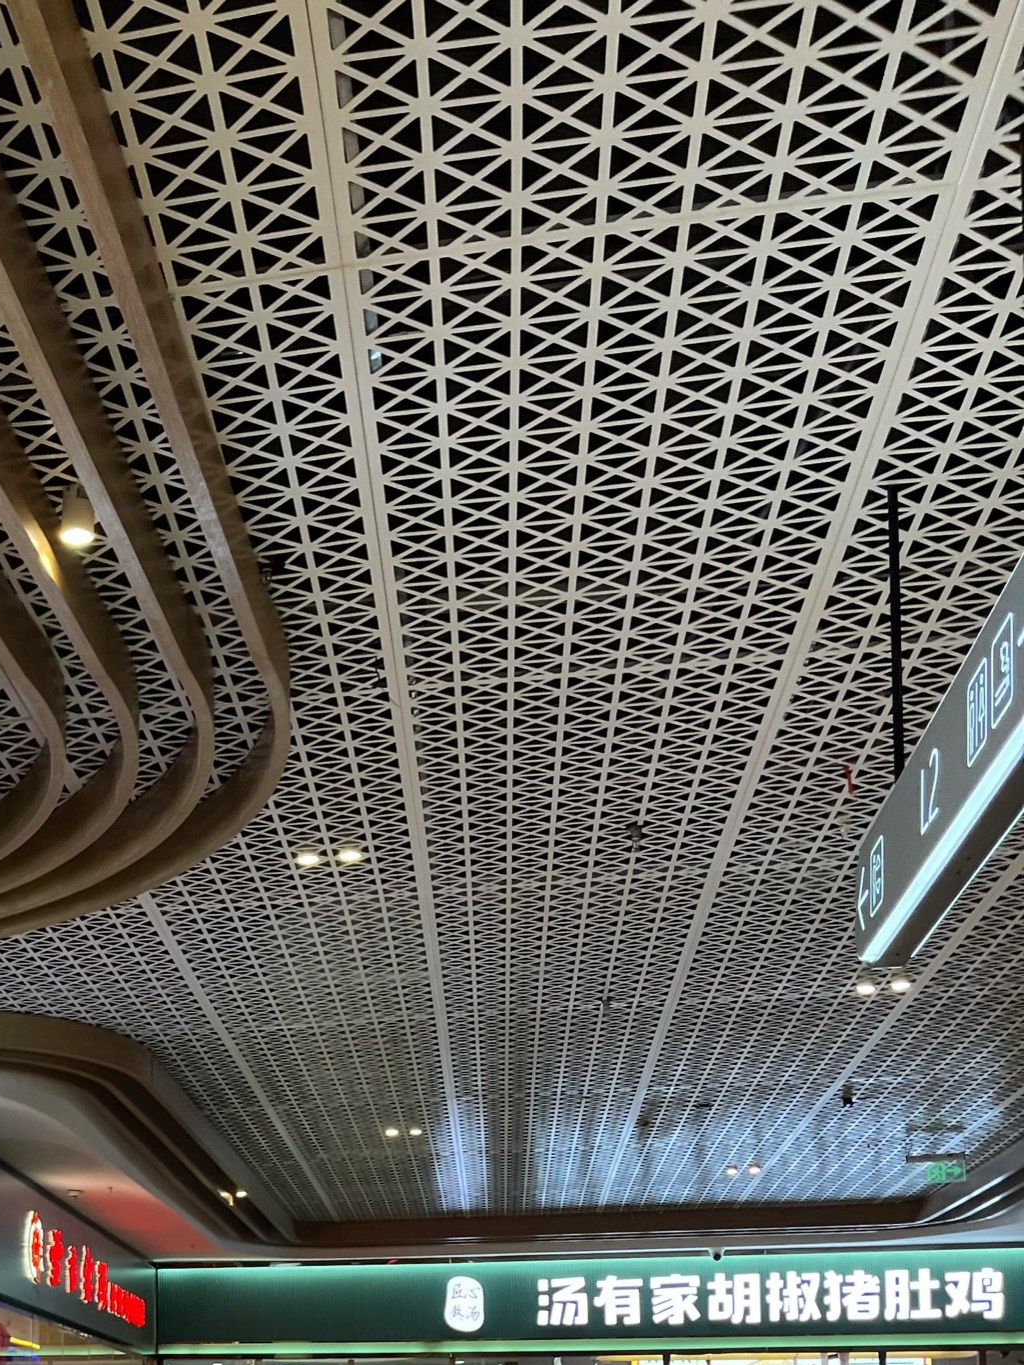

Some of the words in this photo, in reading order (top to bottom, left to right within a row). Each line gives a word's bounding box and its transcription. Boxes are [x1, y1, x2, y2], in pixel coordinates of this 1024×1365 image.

[920, 747, 939, 836] L2
[536, 1267, 1006, 1327] 汤有家胡椒猪肚鸡
